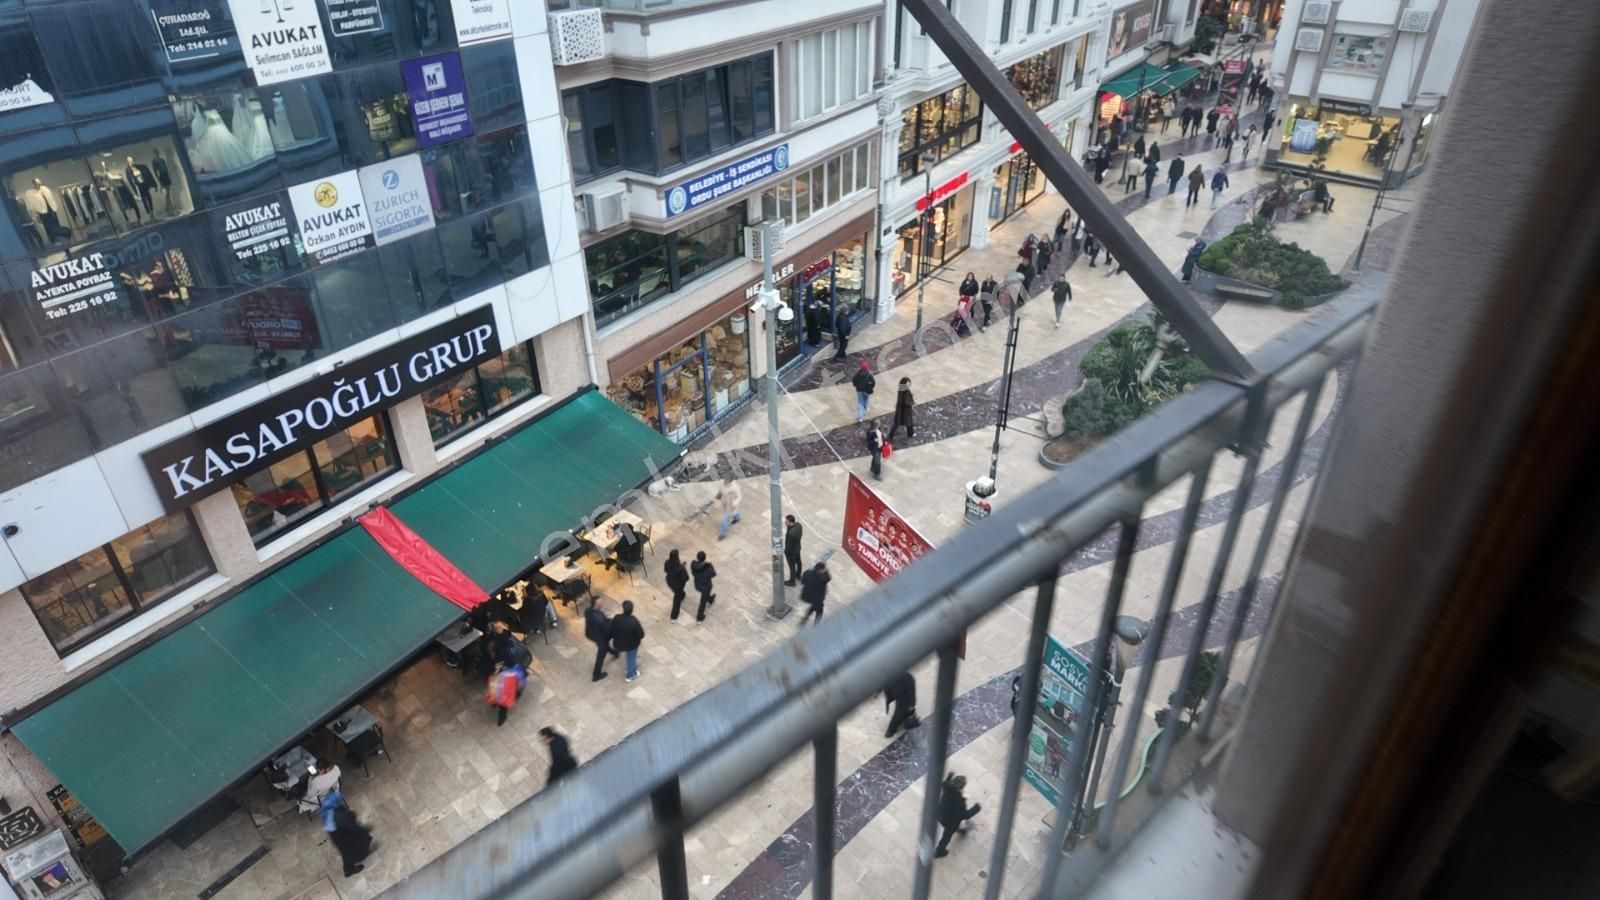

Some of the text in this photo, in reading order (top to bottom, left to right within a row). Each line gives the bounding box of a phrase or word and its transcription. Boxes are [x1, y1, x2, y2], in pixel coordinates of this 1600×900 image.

[252, 25, 317, 49] AVUKAT
[255, 44, 323, 65] Selimcan SAĞLAM
[260, 69, 274, 78] Tel:
[427, 73, 438, 86] M
[689, 172, 725, 194] BELEDİYE
[738, 153, 773, 175] SENDİKASI
[691, 164, 773, 206] ORDU ŞUBE BAŞKANLIĞI
[373, 189, 419, 213] ZURICH
[225, 202, 280, 232] AVUKAT
[303, 203, 361, 234] AVUKAT
[253, 243, 268, 255] 225
[280, 236, 291, 247] 92
[307, 221, 366, 247] Özkan AYDIN
[31, 252, 104, 288] AVUKAT
[36, 271, 112, 301] A.YEKTA POYRAZ
[46, 291, 118, 320] Tel: 225 16 92
[162, 323, 492, 500] KASAPOĞLU GRUP
[1050, 658, 1087, 692] MARK
[1053, 650, 1088, 684] SOSYA
